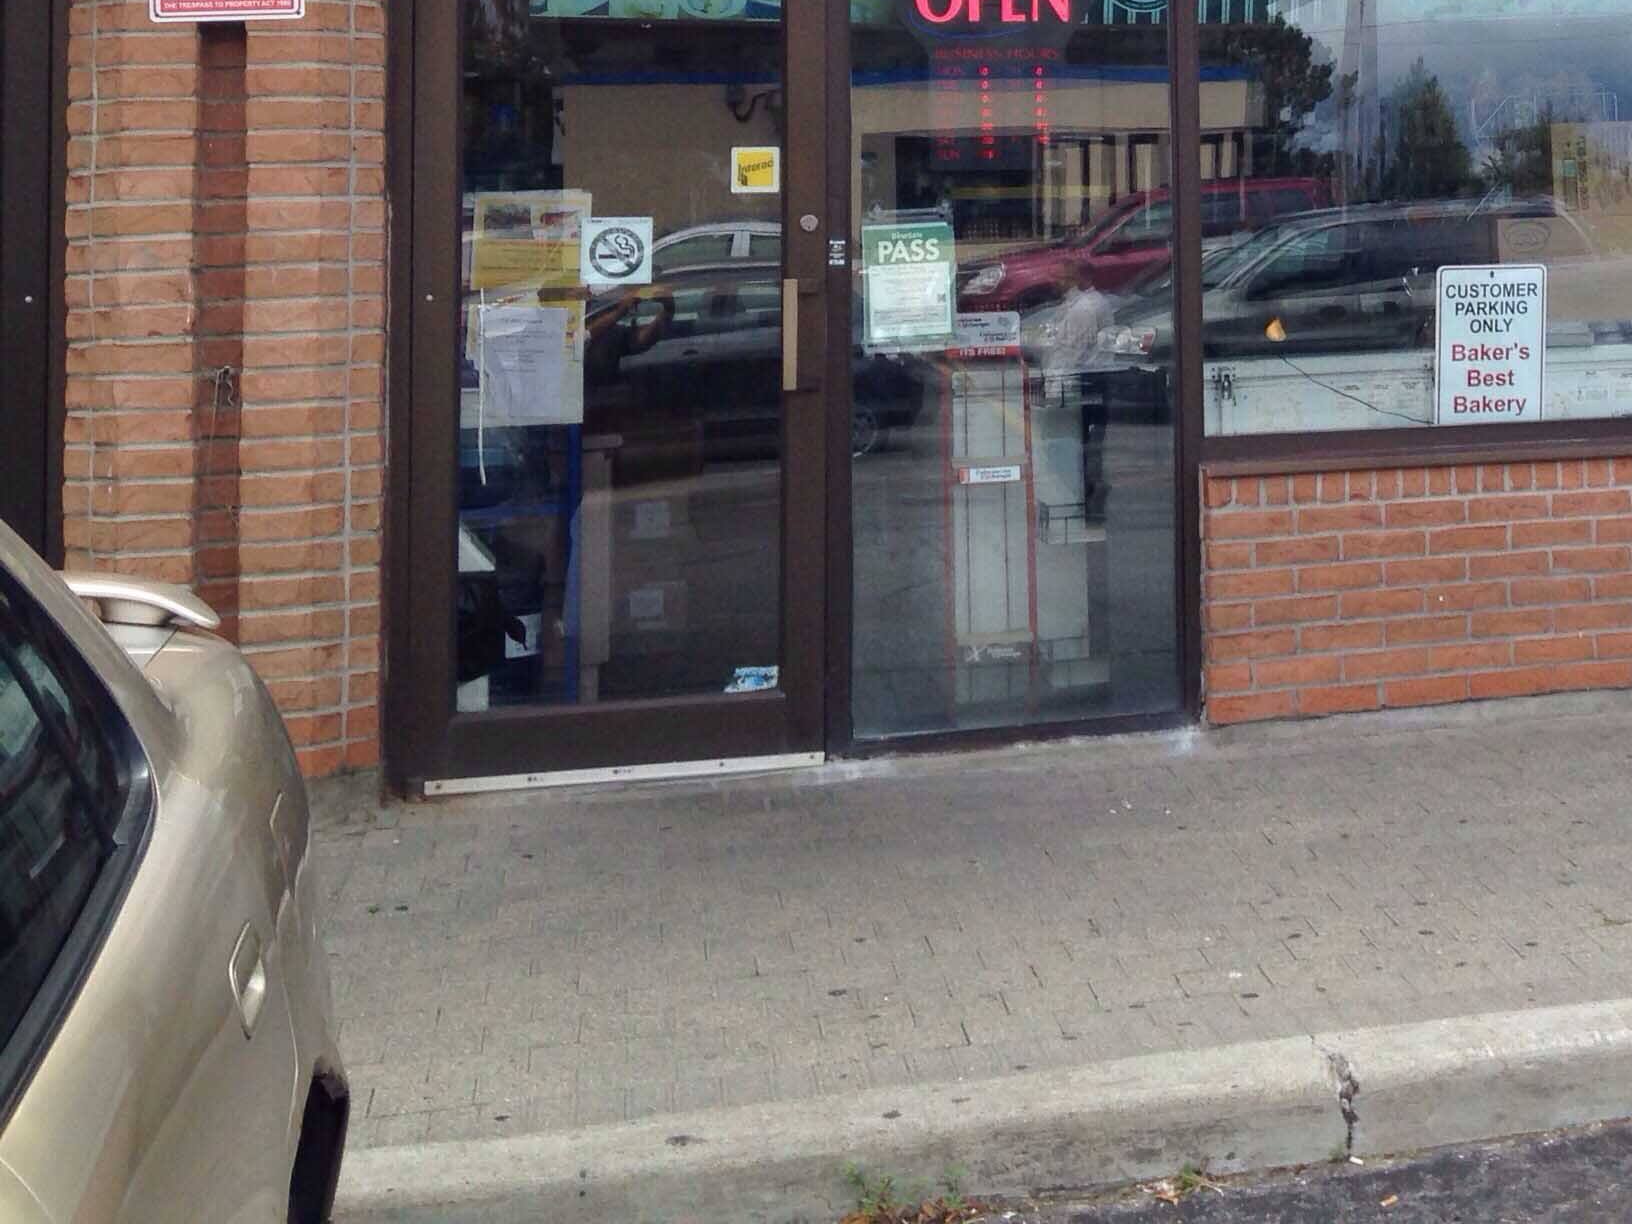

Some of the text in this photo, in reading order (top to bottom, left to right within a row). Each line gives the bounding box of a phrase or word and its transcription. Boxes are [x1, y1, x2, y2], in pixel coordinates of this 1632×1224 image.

[225, 0, 260, 8] PROPERTY
[878, 238, 941, 263] PASS
[1445, 283, 1538, 299] CUSTOMER
[1455, 301, 1528, 316] PARKING
[1470, 319, 1513, 334] ONLY
[1451, 343, 1530, 361] Baker's
[1467, 369, 1515, 387] Best
[1453, 396, 1527, 416] Bakery
